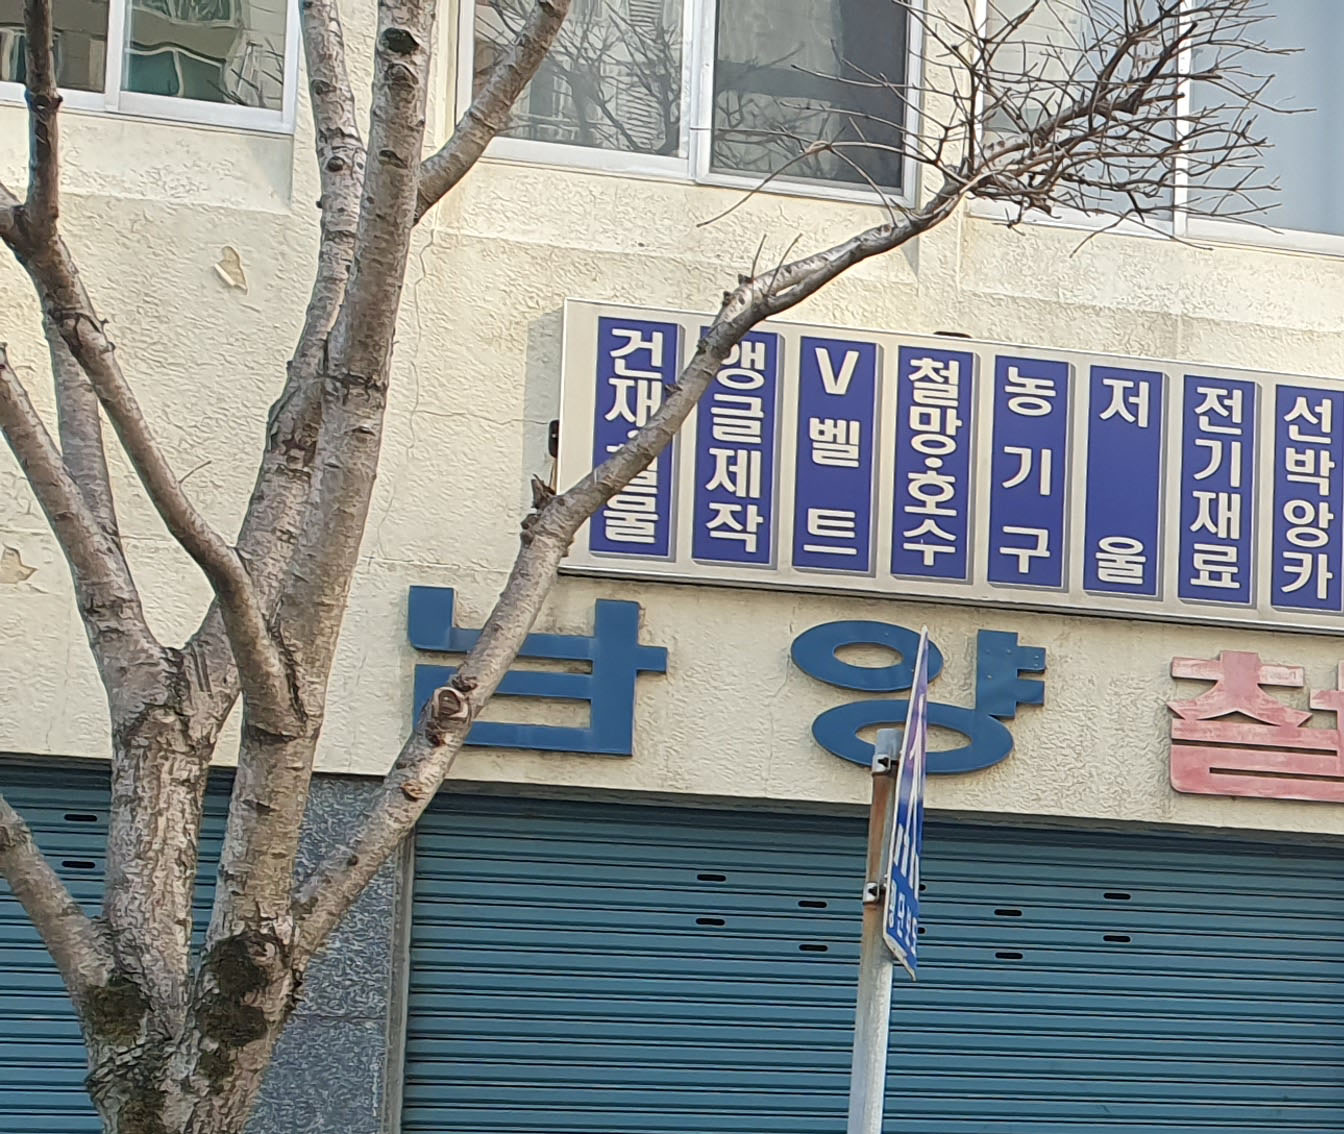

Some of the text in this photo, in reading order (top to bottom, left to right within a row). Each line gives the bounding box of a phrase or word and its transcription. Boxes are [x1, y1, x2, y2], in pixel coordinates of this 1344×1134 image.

[705, 341, 766, 553] 앵글제작
[903, 355, 963, 566] 철망·호수
[1000, 367, 1058, 575] 농기구
[1095, 377, 1150, 586] 저울
[1189, 386, 1243, 590] 전기재료
[1282, 395, 1336, 601] 선박앙카
